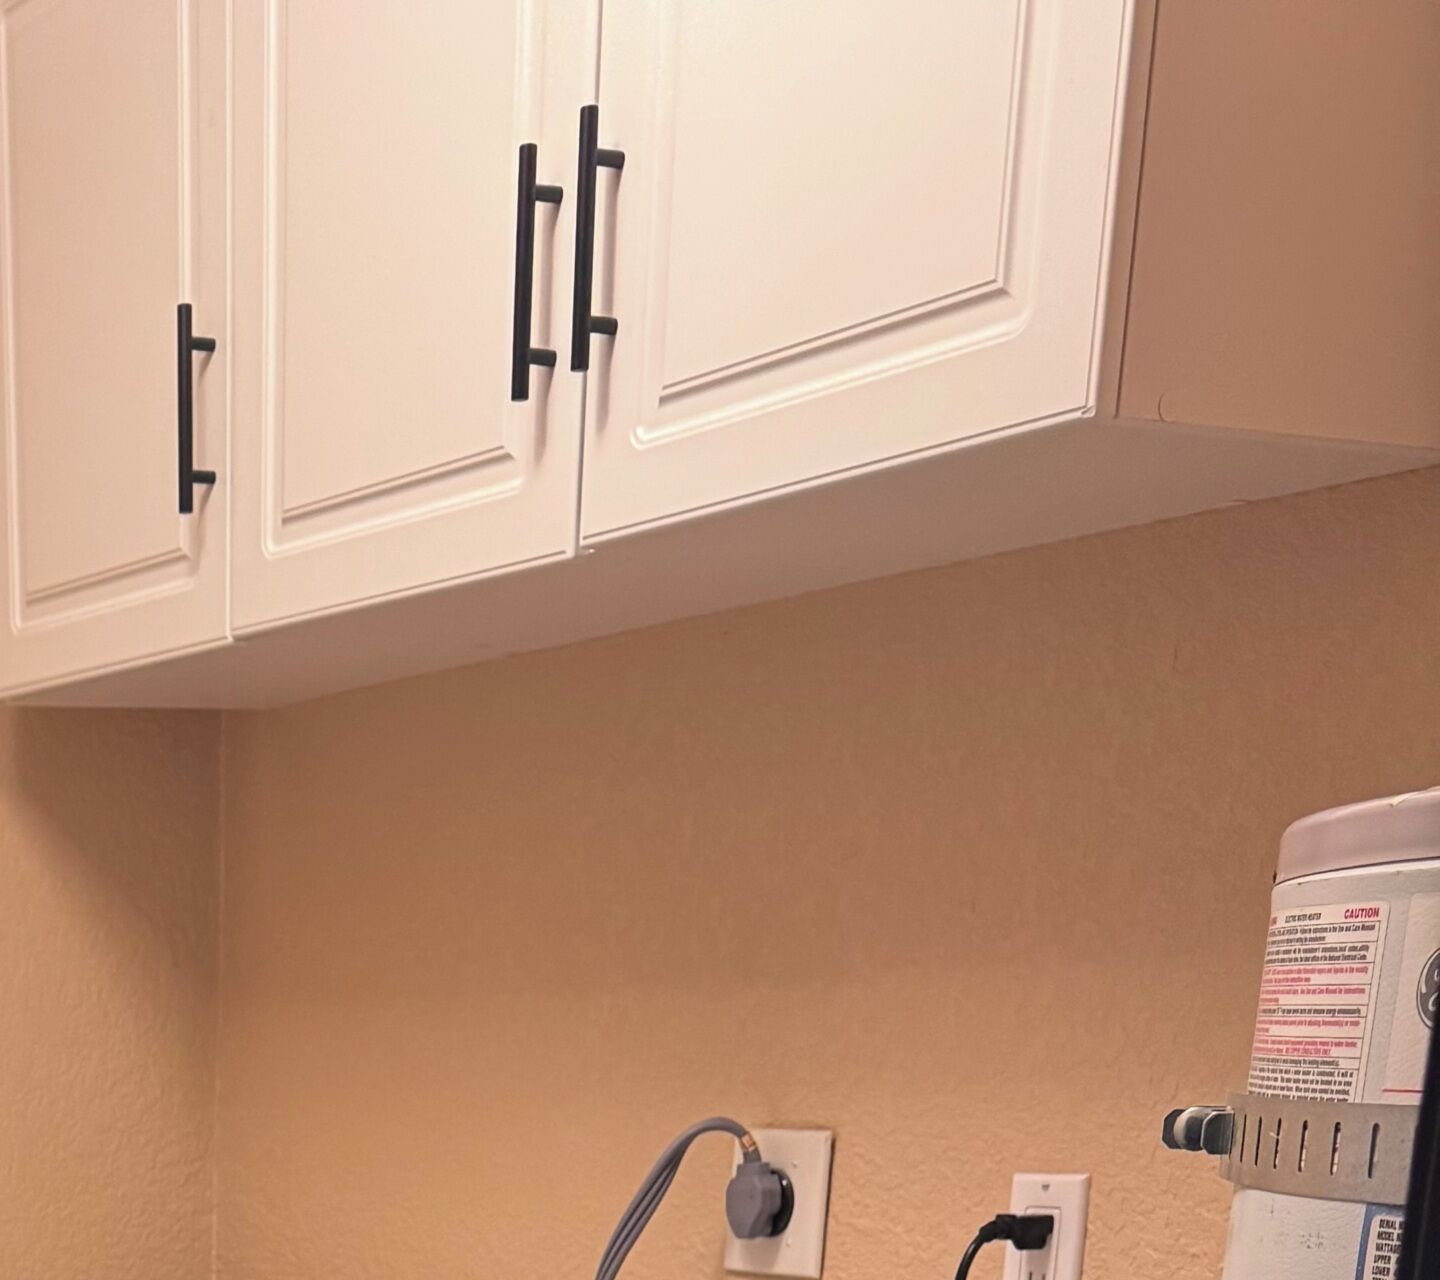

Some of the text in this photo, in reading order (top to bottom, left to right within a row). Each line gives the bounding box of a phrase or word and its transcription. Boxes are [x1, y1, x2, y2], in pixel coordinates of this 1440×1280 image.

[1344, 907, 1380, 919] CAUTION
[1379, 1219, 1397, 1230] SERIAL
[1377, 1230, 1395, 1242] MODEL
[1373, 1254, 1391, 1265] UPPER
[1372, 1266, 1391, 1277] LOWER
